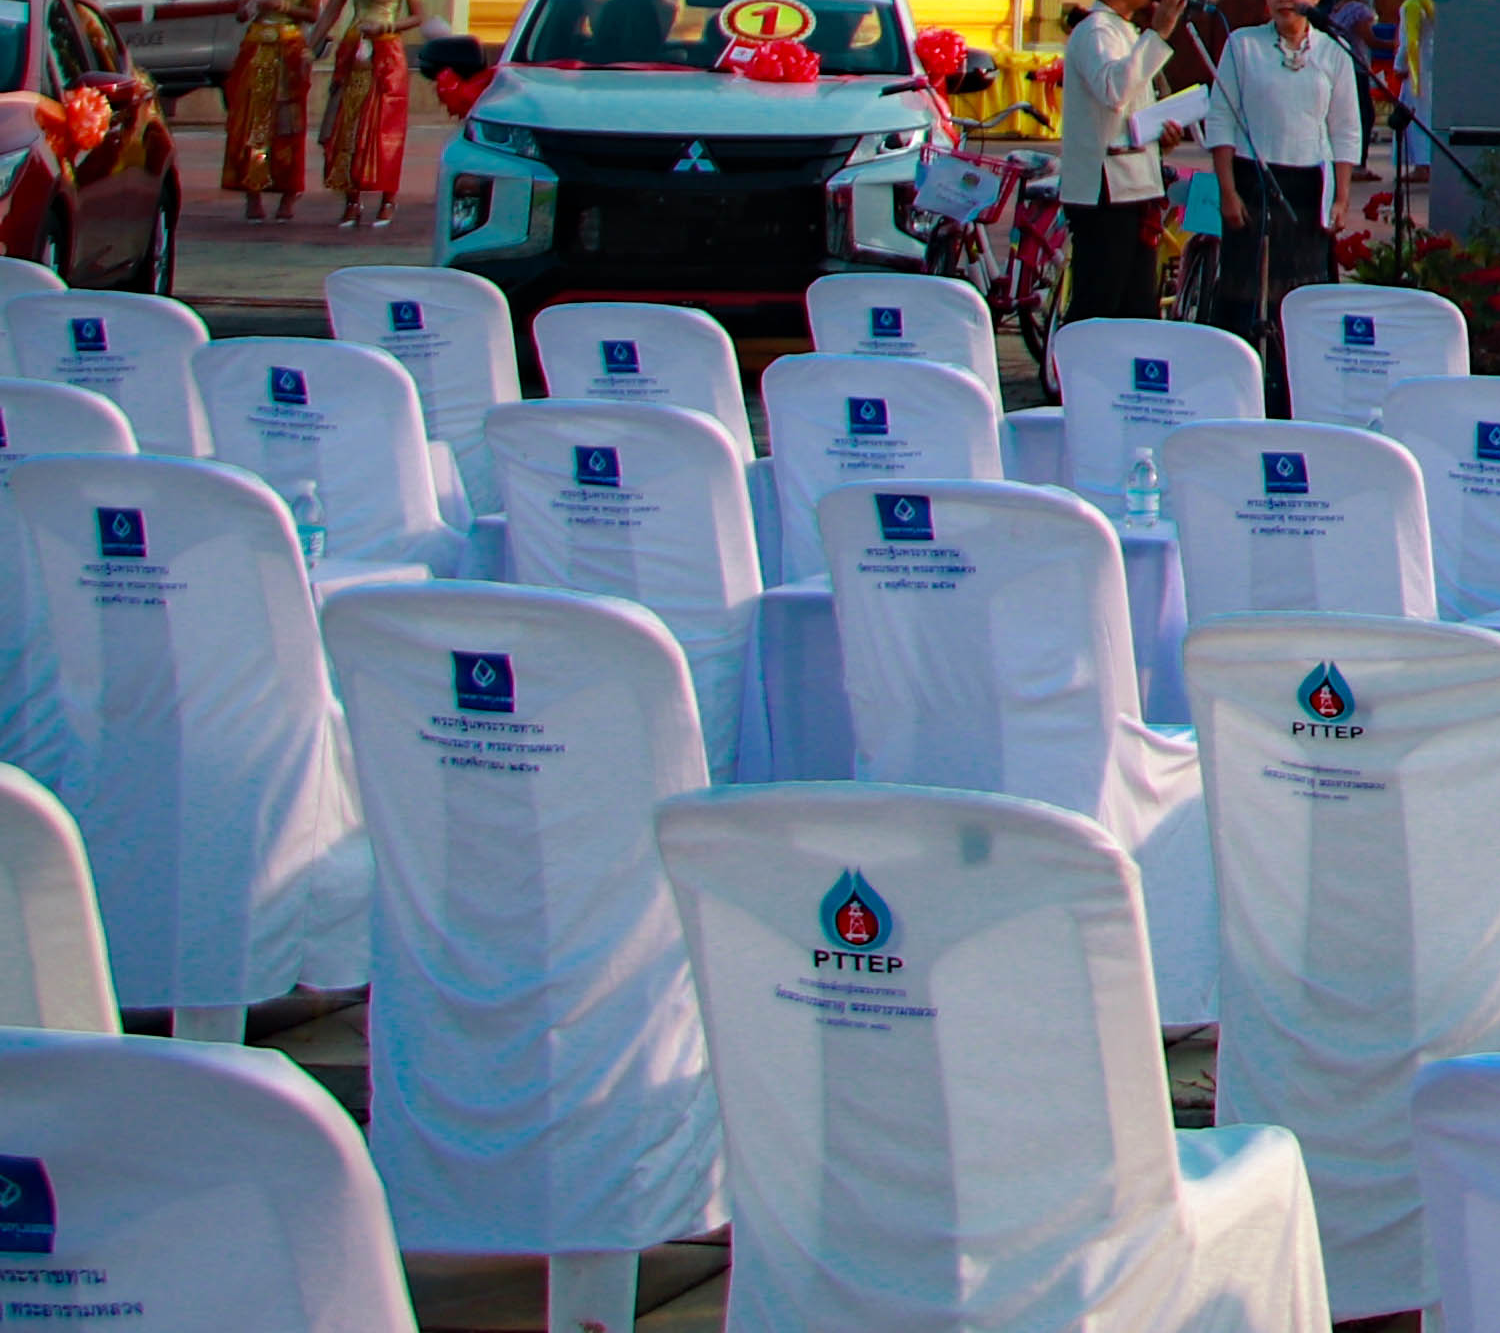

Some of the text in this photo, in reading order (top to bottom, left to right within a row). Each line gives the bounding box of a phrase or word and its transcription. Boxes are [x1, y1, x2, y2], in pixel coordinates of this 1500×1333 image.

[751, 5, 780, 36] 1
[1292, 721, 1364, 740] PTTEP
[814, 949, 904, 974] PTTEP
[8, 1301, 145, 1318] พระอารามหลวง
